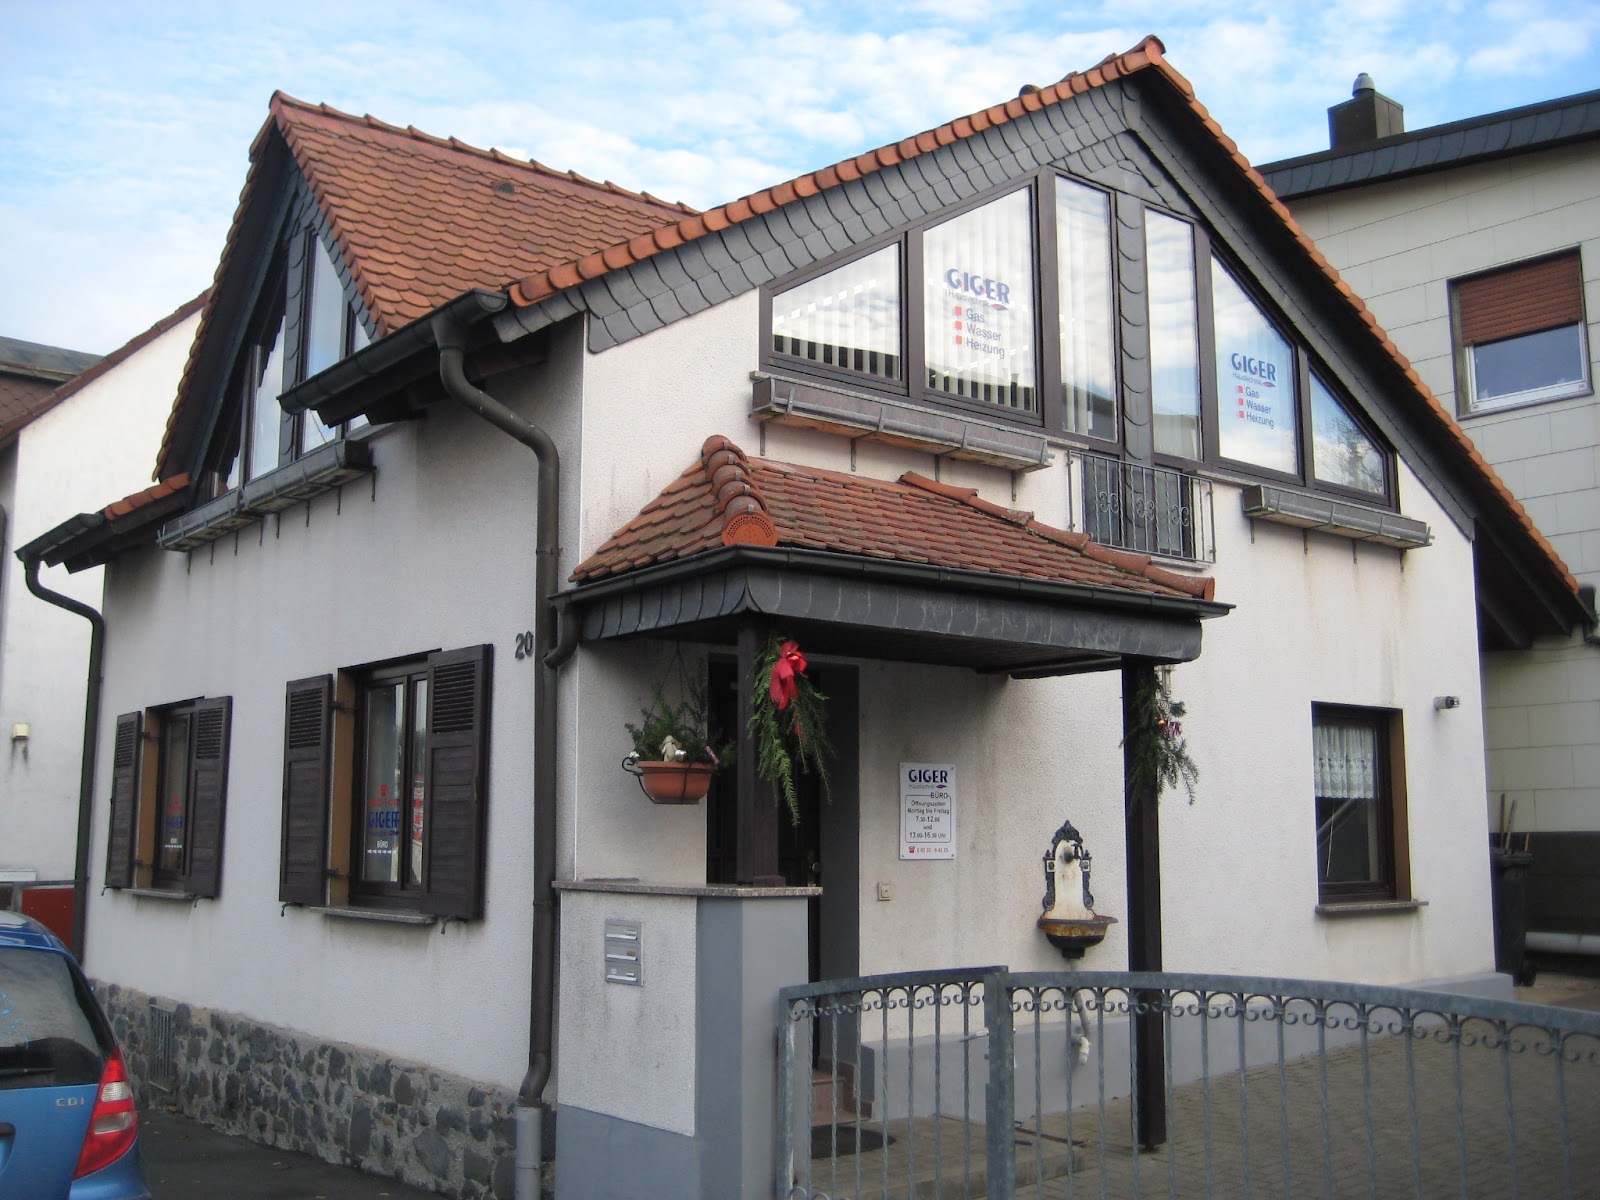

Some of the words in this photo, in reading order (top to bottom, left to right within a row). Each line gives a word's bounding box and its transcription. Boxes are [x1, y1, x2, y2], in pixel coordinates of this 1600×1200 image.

[946, 268, 1010, 304] GIGER
[966, 308, 985, 323] Gas
[966, 323, 1002, 342] Wasser
[965, 337, 1005, 360] Heizung
[1231, 352, 1276, 381] GIGER
[1245, 386, 1260, 398] Gas
[1246, 399, 1272, 414] Wasser
[1246, 411, 1275, 430] Heizung
[515, 630, 534, 660] 20
[908, 769, 948, 783] GIGER
[930, 791, 949, 799] BÜRO
[911, 800, 946, 808] Öffnungszeiten
[368, 811, 399, 828] GIGER
[56, 1097, 85, 1107] CDI
